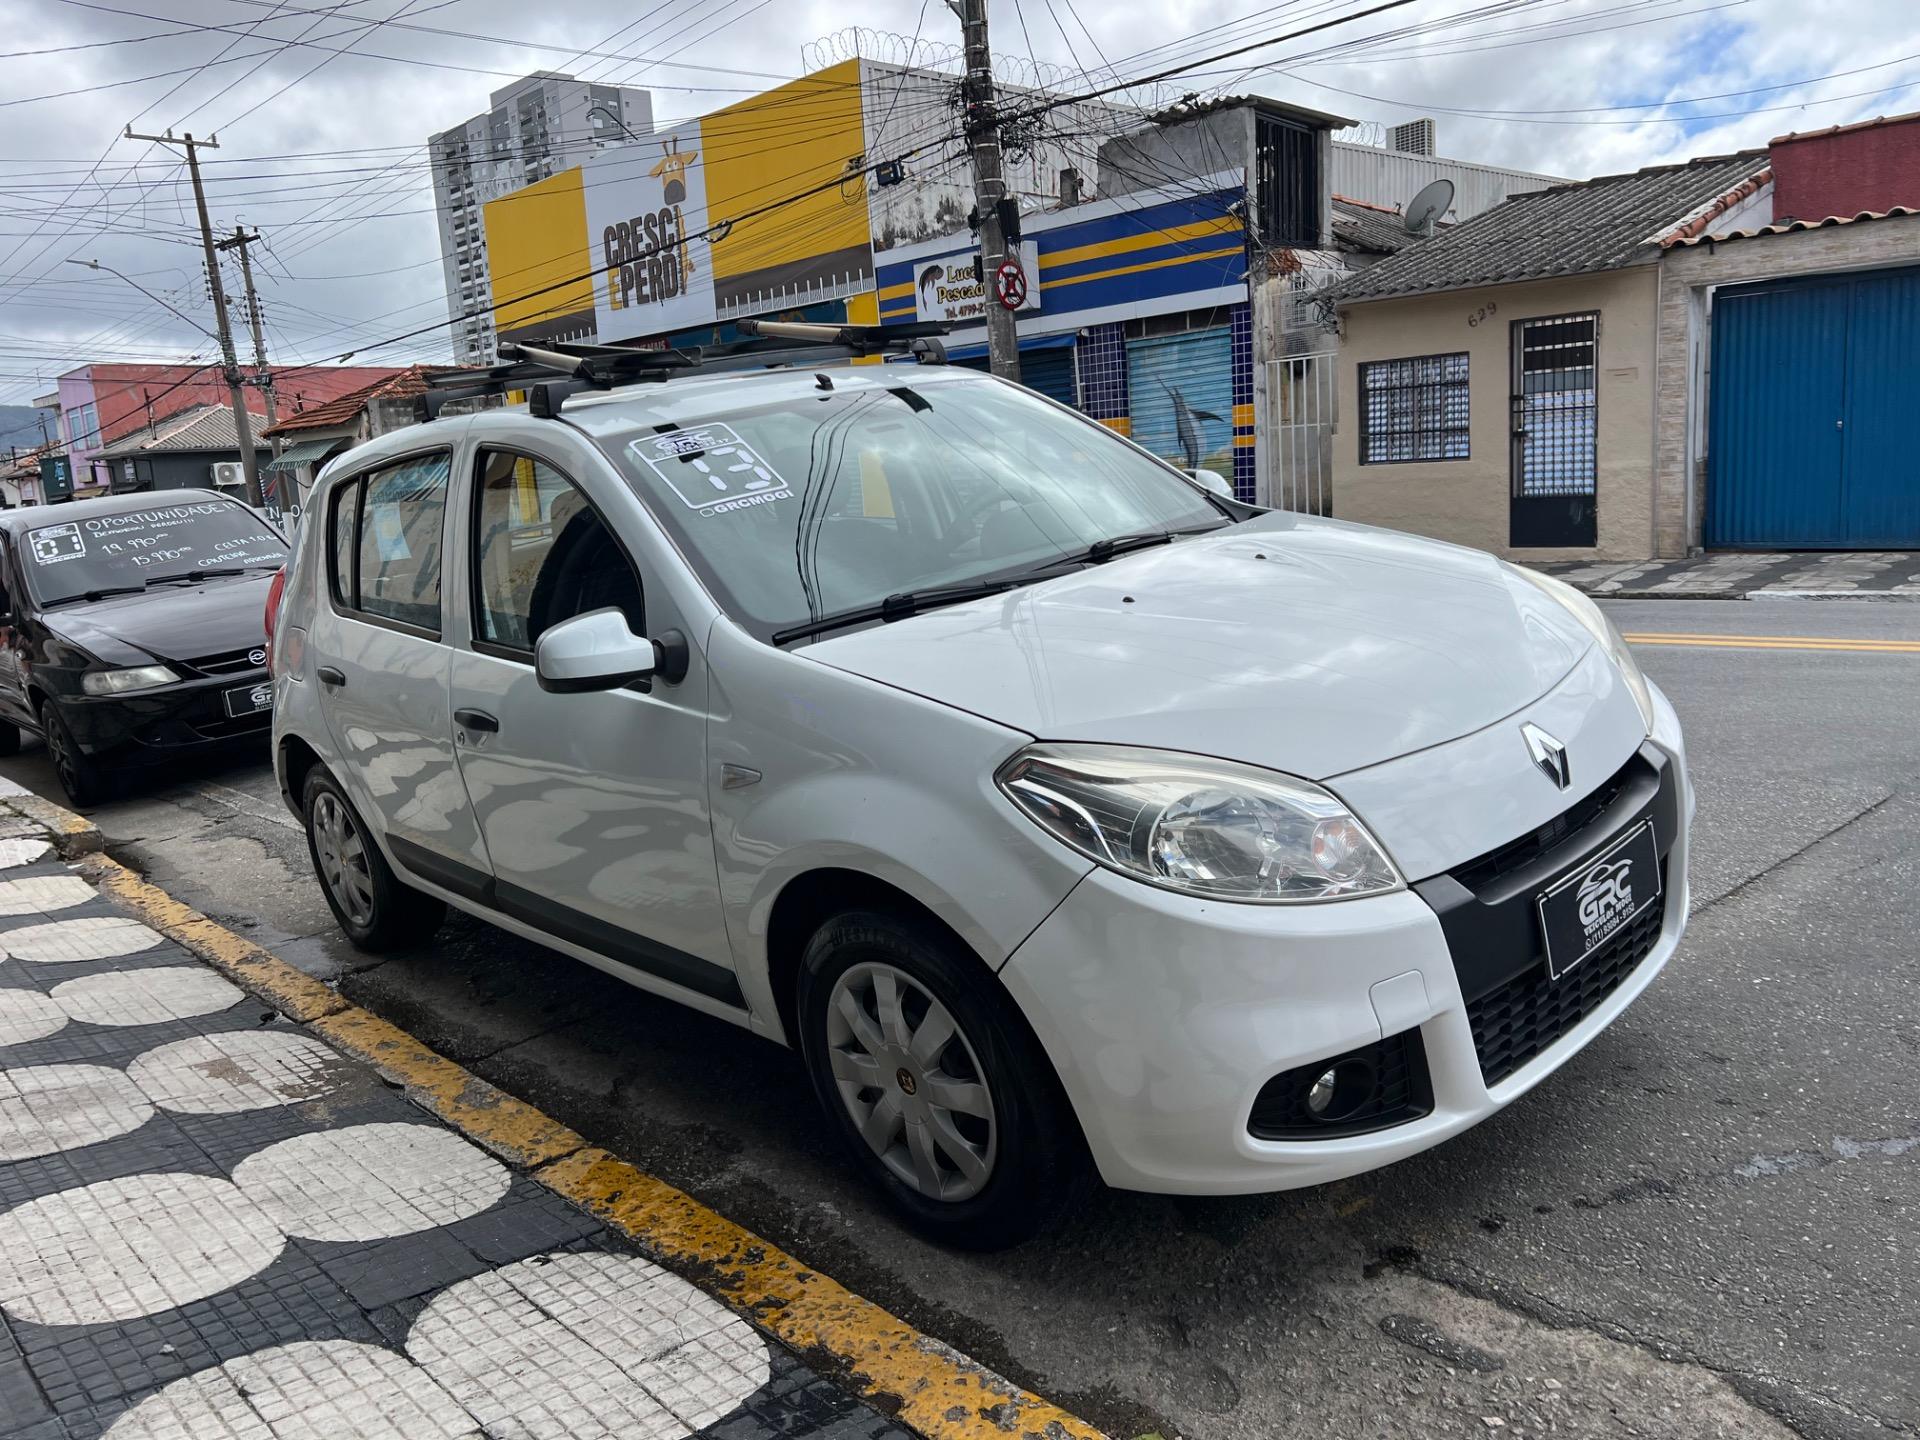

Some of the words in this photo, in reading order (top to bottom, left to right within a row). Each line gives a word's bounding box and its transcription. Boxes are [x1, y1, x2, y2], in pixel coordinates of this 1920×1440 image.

[1467, 301, 1497, 328] 629
[714, 489, 795, 514] GRCMOGI
[1579, 866, 1632, 926] GRC
